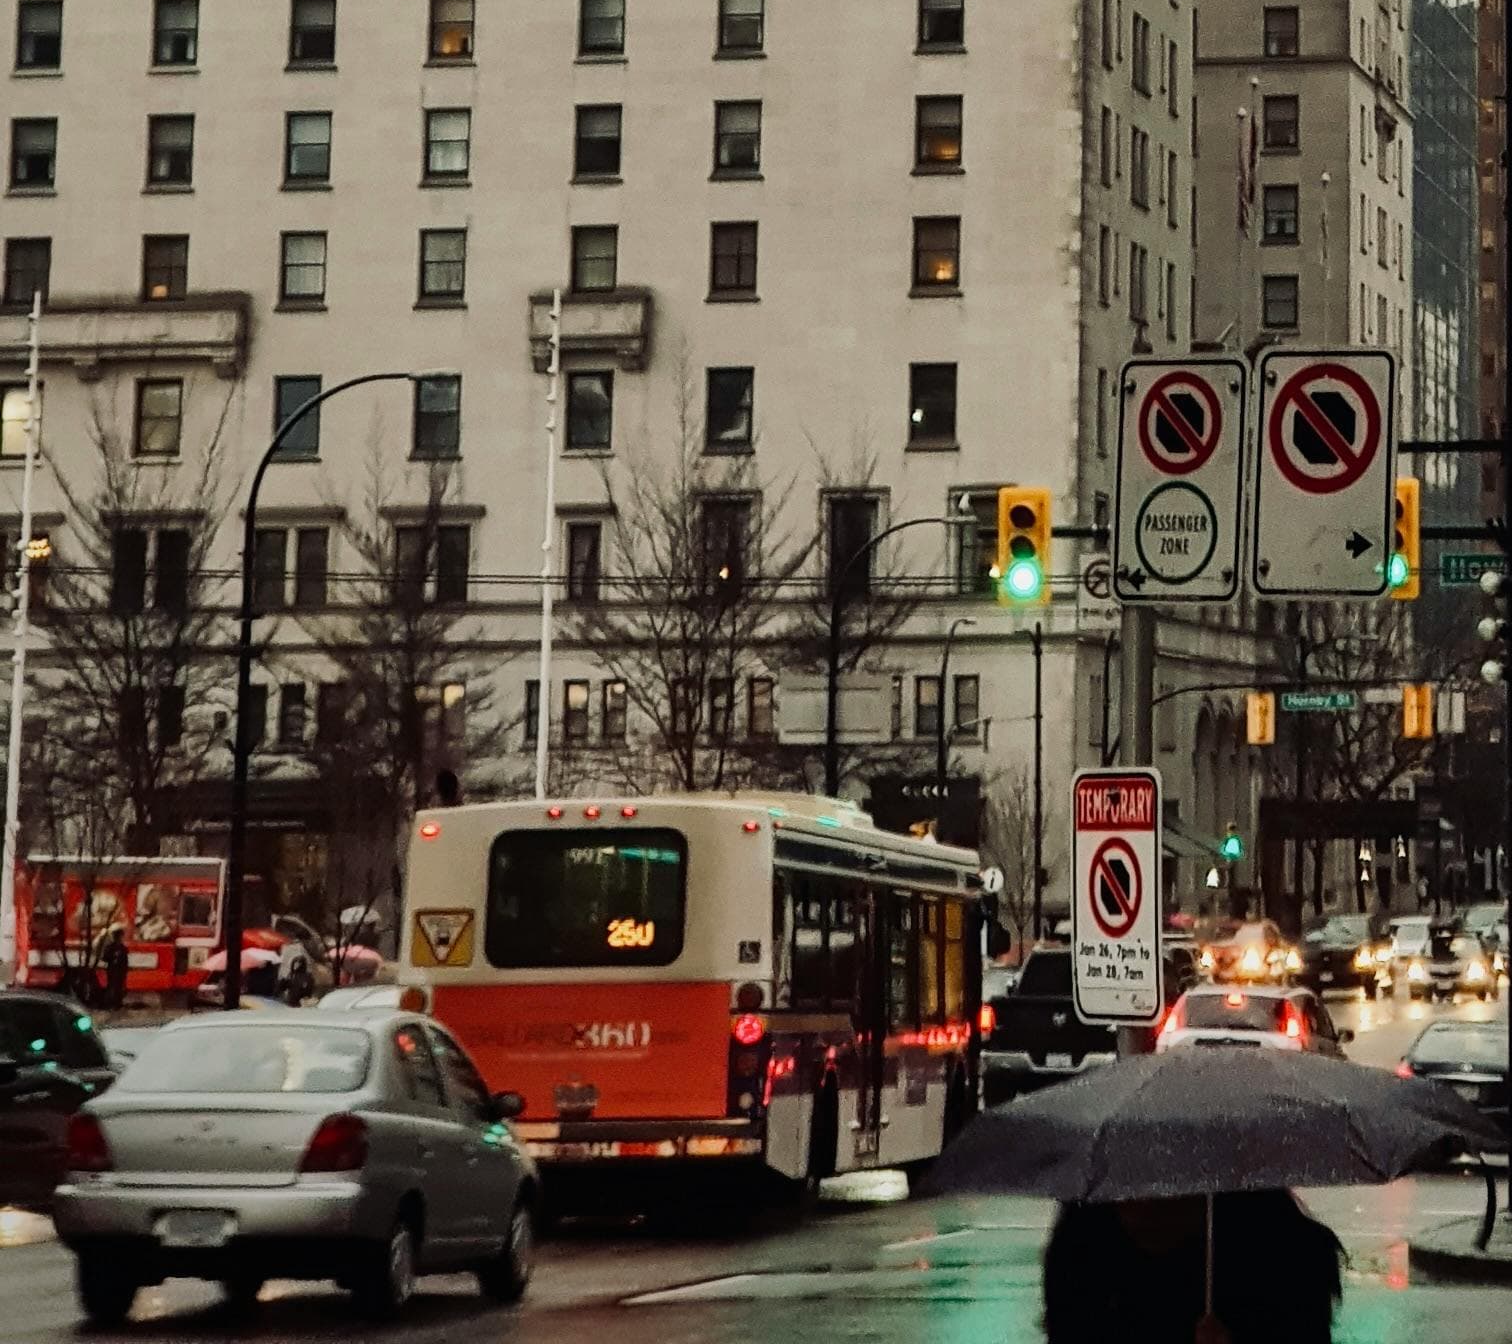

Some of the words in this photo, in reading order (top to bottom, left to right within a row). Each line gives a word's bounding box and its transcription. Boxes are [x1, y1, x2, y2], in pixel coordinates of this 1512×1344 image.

[1144, 514, 1207, 532] PASSENGER
[1160, 537, 1190, 555] ZONE
[1288, 694, 1331, 708] Hornby
[1079, 787, 1153, 824] TEMPORARY
[1080, 942, 1096, 955] Jan
[1117, 944, 1137, 962] 7pm
[1141, 945, 1150, 960] to
[1086, 963, 1102, 977] Jan
[1124, 966, 1144, 980] 7am
[574, 1022, 651, 1047] 360
